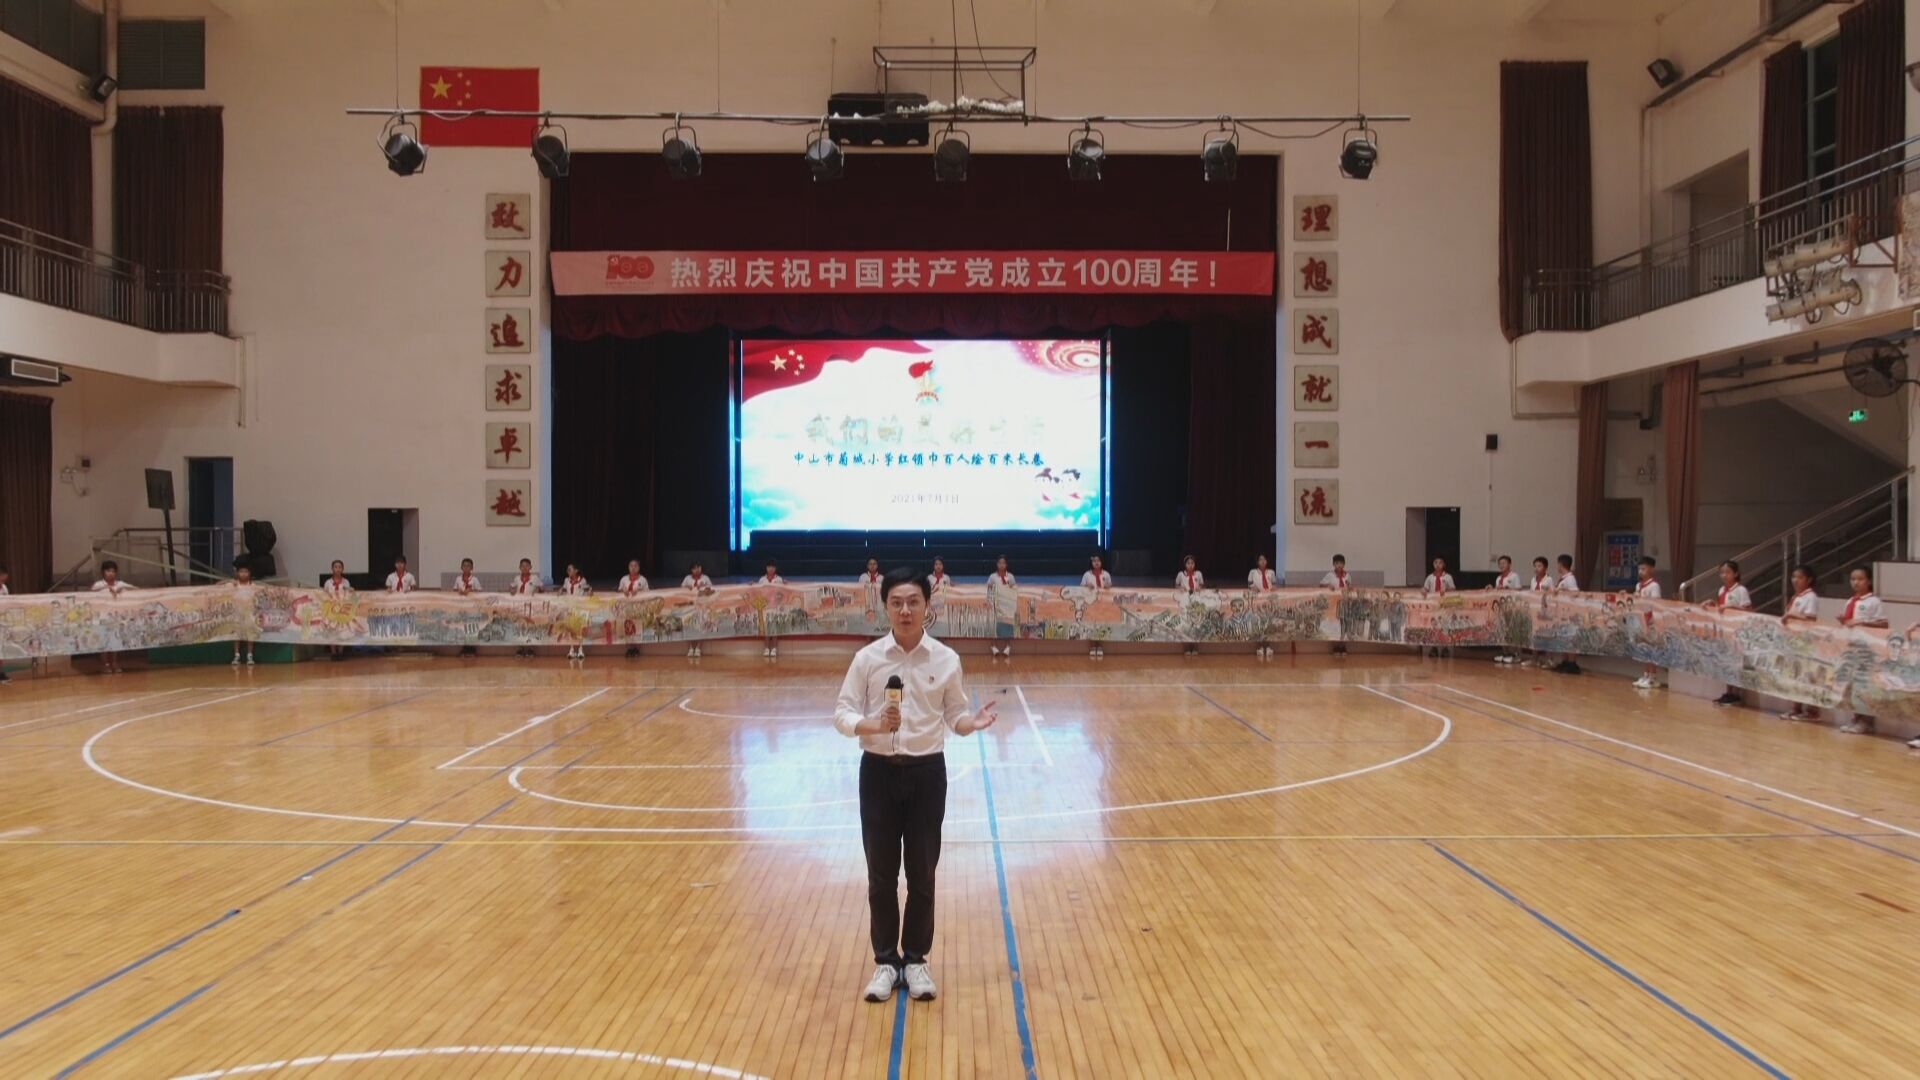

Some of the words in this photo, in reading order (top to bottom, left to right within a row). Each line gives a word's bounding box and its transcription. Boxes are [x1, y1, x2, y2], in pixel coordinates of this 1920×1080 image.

[489, 200, 526, 518] 致力追求卓越
[670, 255, 1219, 290] 热烈庆祝中国共产党成立100周年！
[1299, 204, 1334, 520] 理想成就一流
[889, 493, 960, 505] 2021年7月1日
